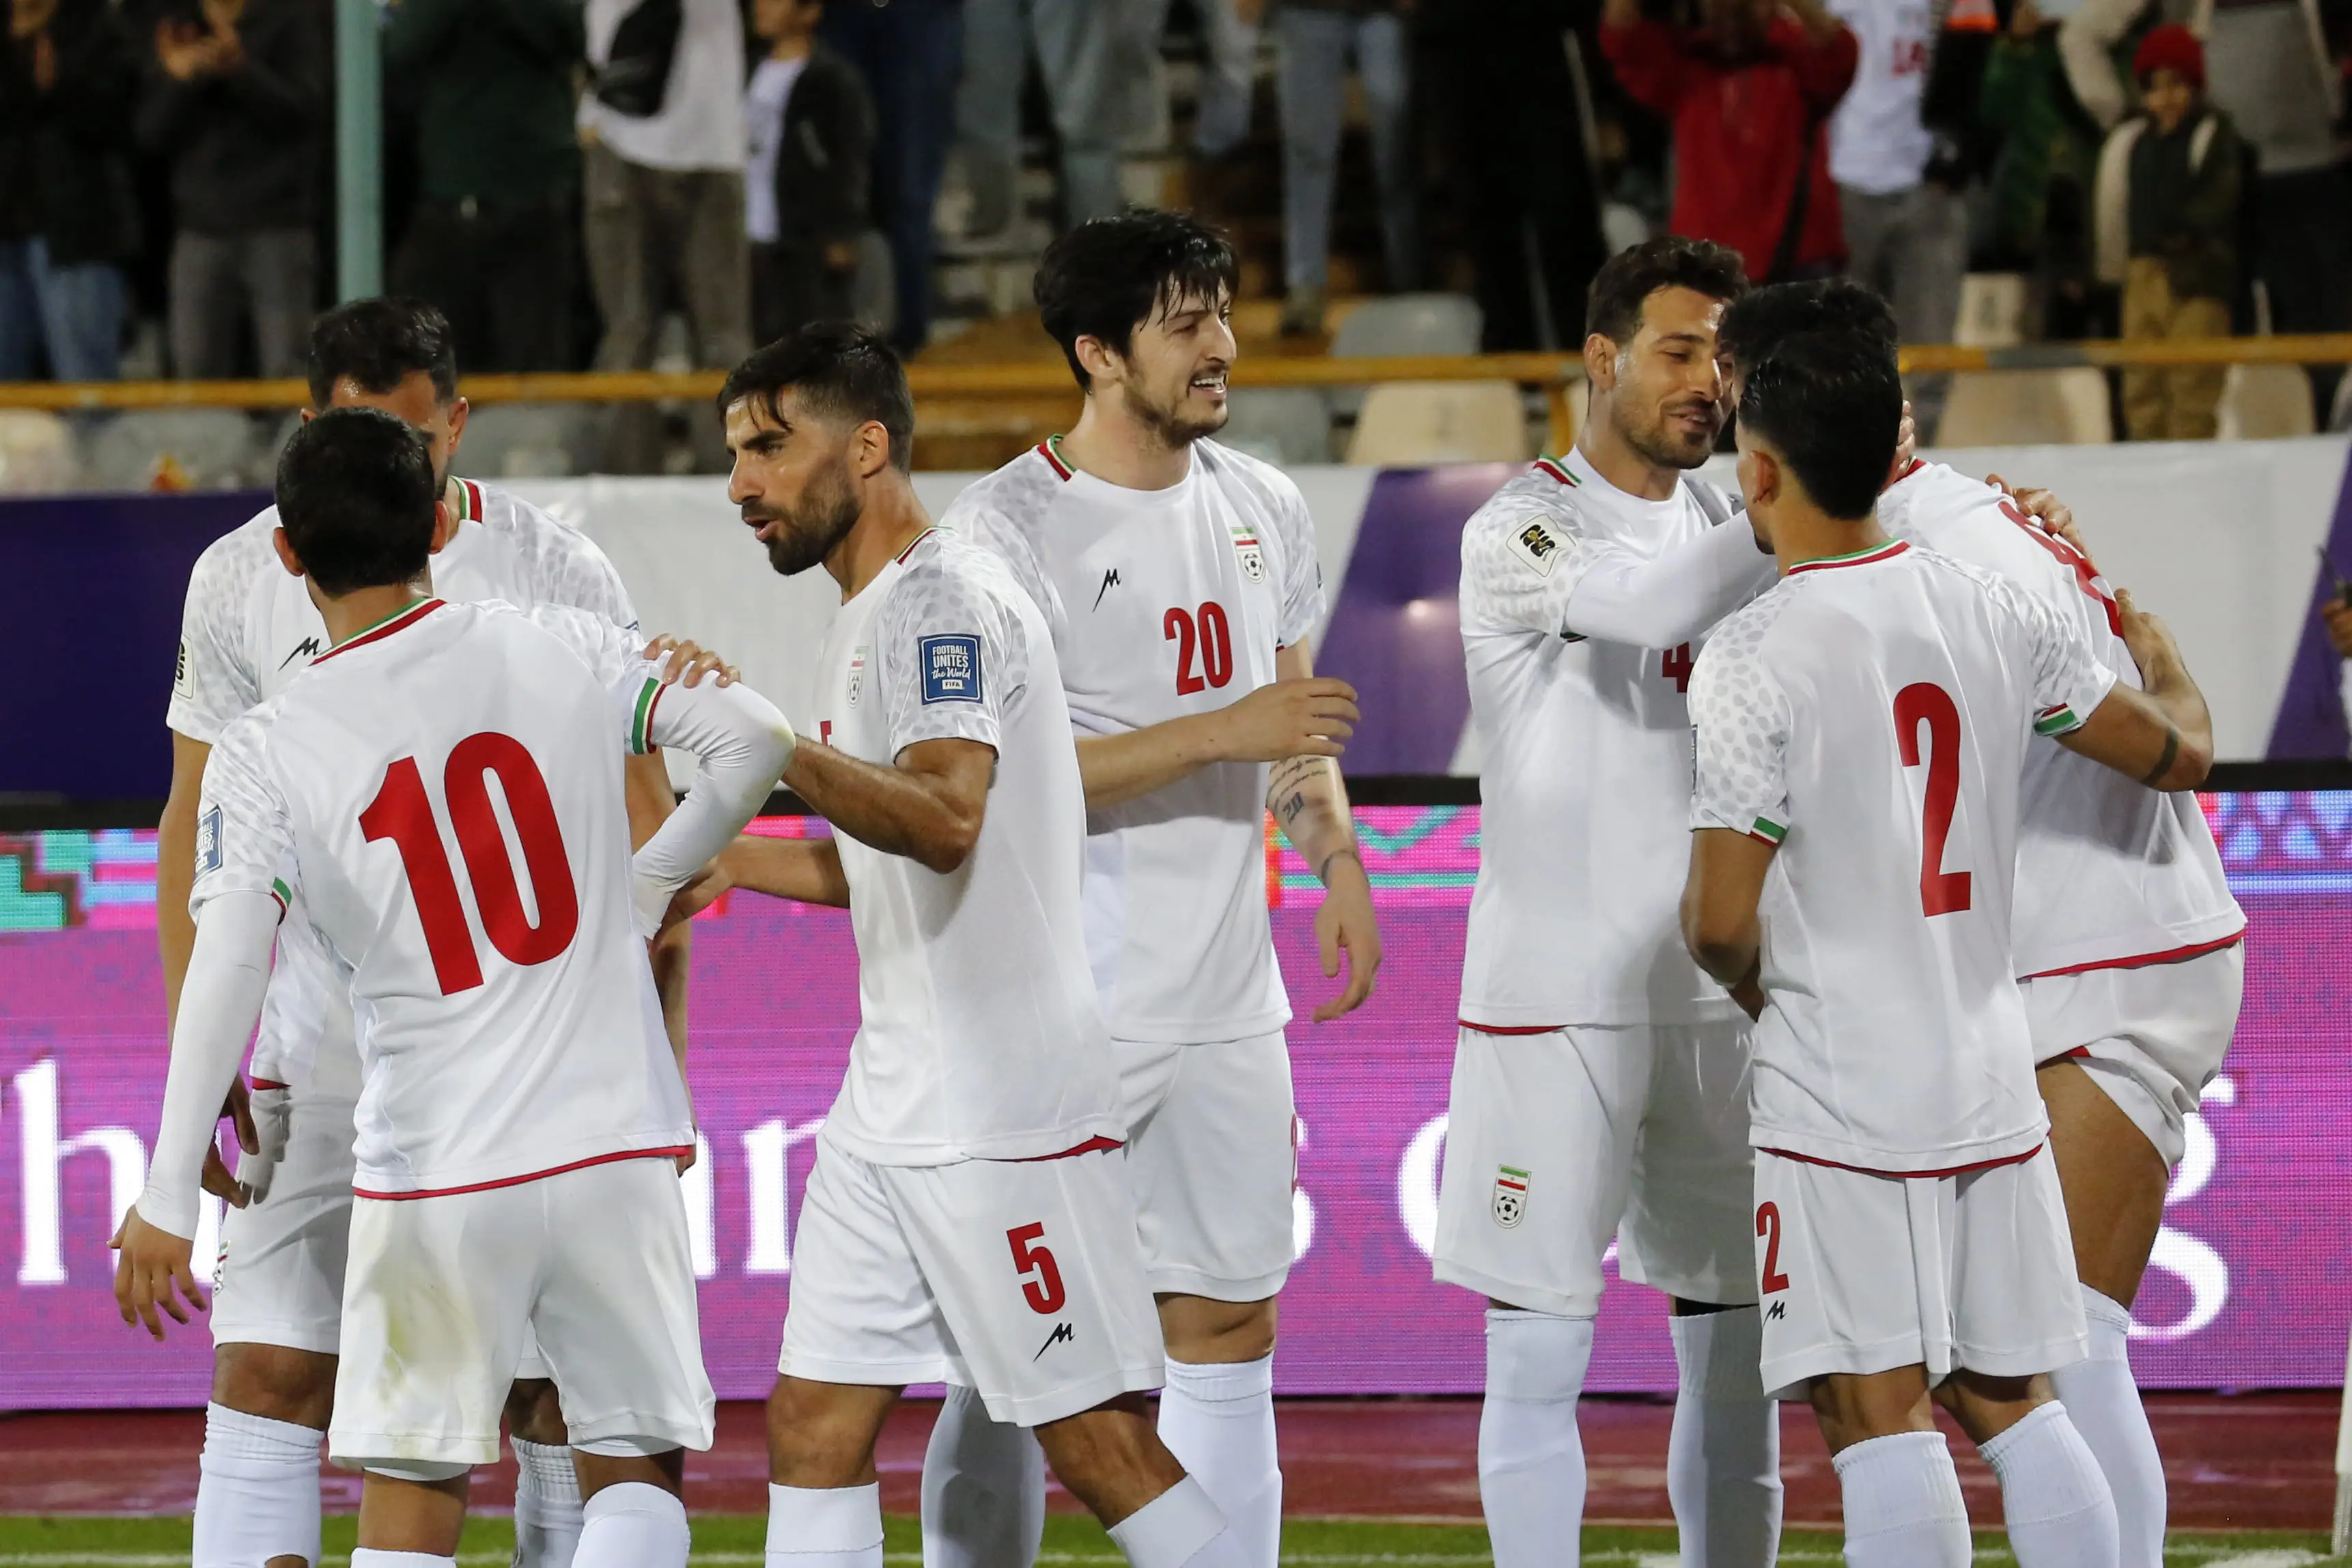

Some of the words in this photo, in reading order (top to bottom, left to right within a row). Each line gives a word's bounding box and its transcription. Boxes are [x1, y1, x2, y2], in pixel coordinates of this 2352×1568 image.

[932, 645, 968, 656] FOOTBALL
[932, 669, 946, 680] the
[946, 667, 970, 680] World
[933, 654, 968, 668] UNITES
[1164, 601, 1233, 696] 20
[1662, 641, 1695, 693] 4
[1893, 682, 1972, 917] 2
[359, 731, 578, 996] 10
[1006, 1221, 1065, 1315] 5
[1756, 1201, 1790, 1295] 2
